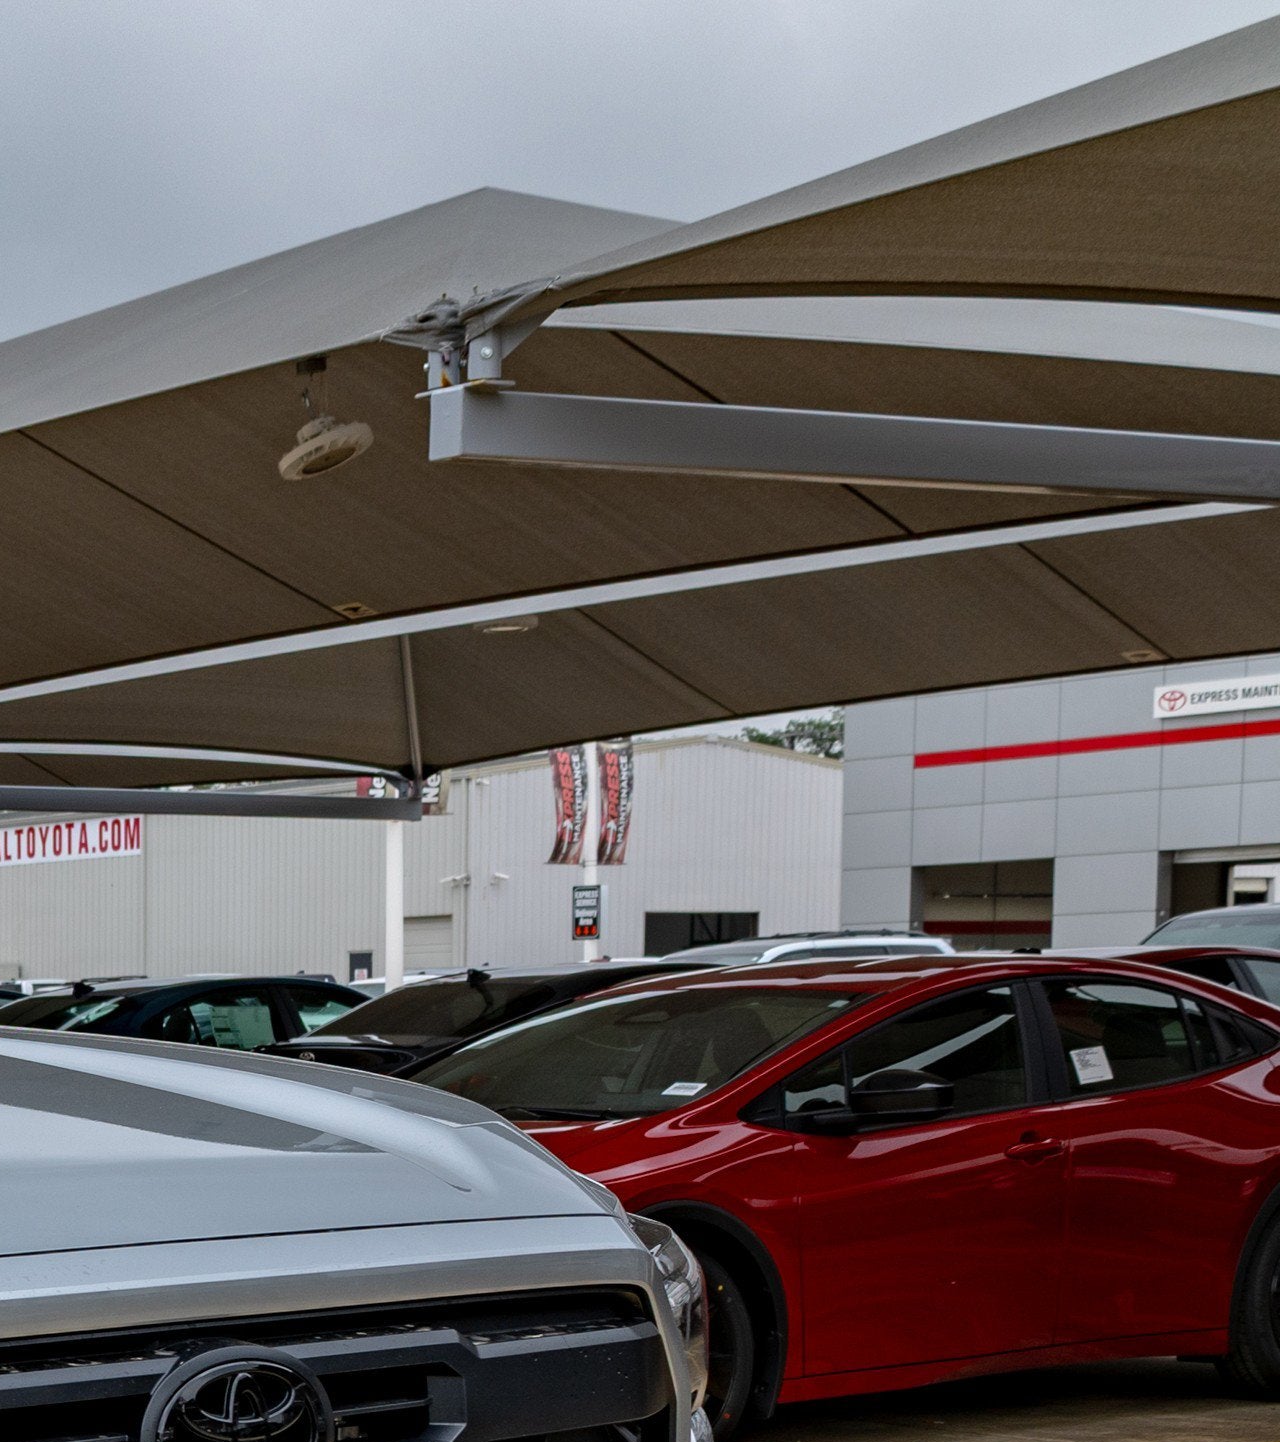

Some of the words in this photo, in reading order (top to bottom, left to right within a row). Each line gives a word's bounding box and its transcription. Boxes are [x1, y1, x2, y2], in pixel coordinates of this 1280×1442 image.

[1190, 688, 1239, 705] EXPRESS
[1242, 684, 1280, 699] MAINT
[571, 753, 583, 843] MAINTENANCE
[617, 755, 628, 843] MAINTENANCE
